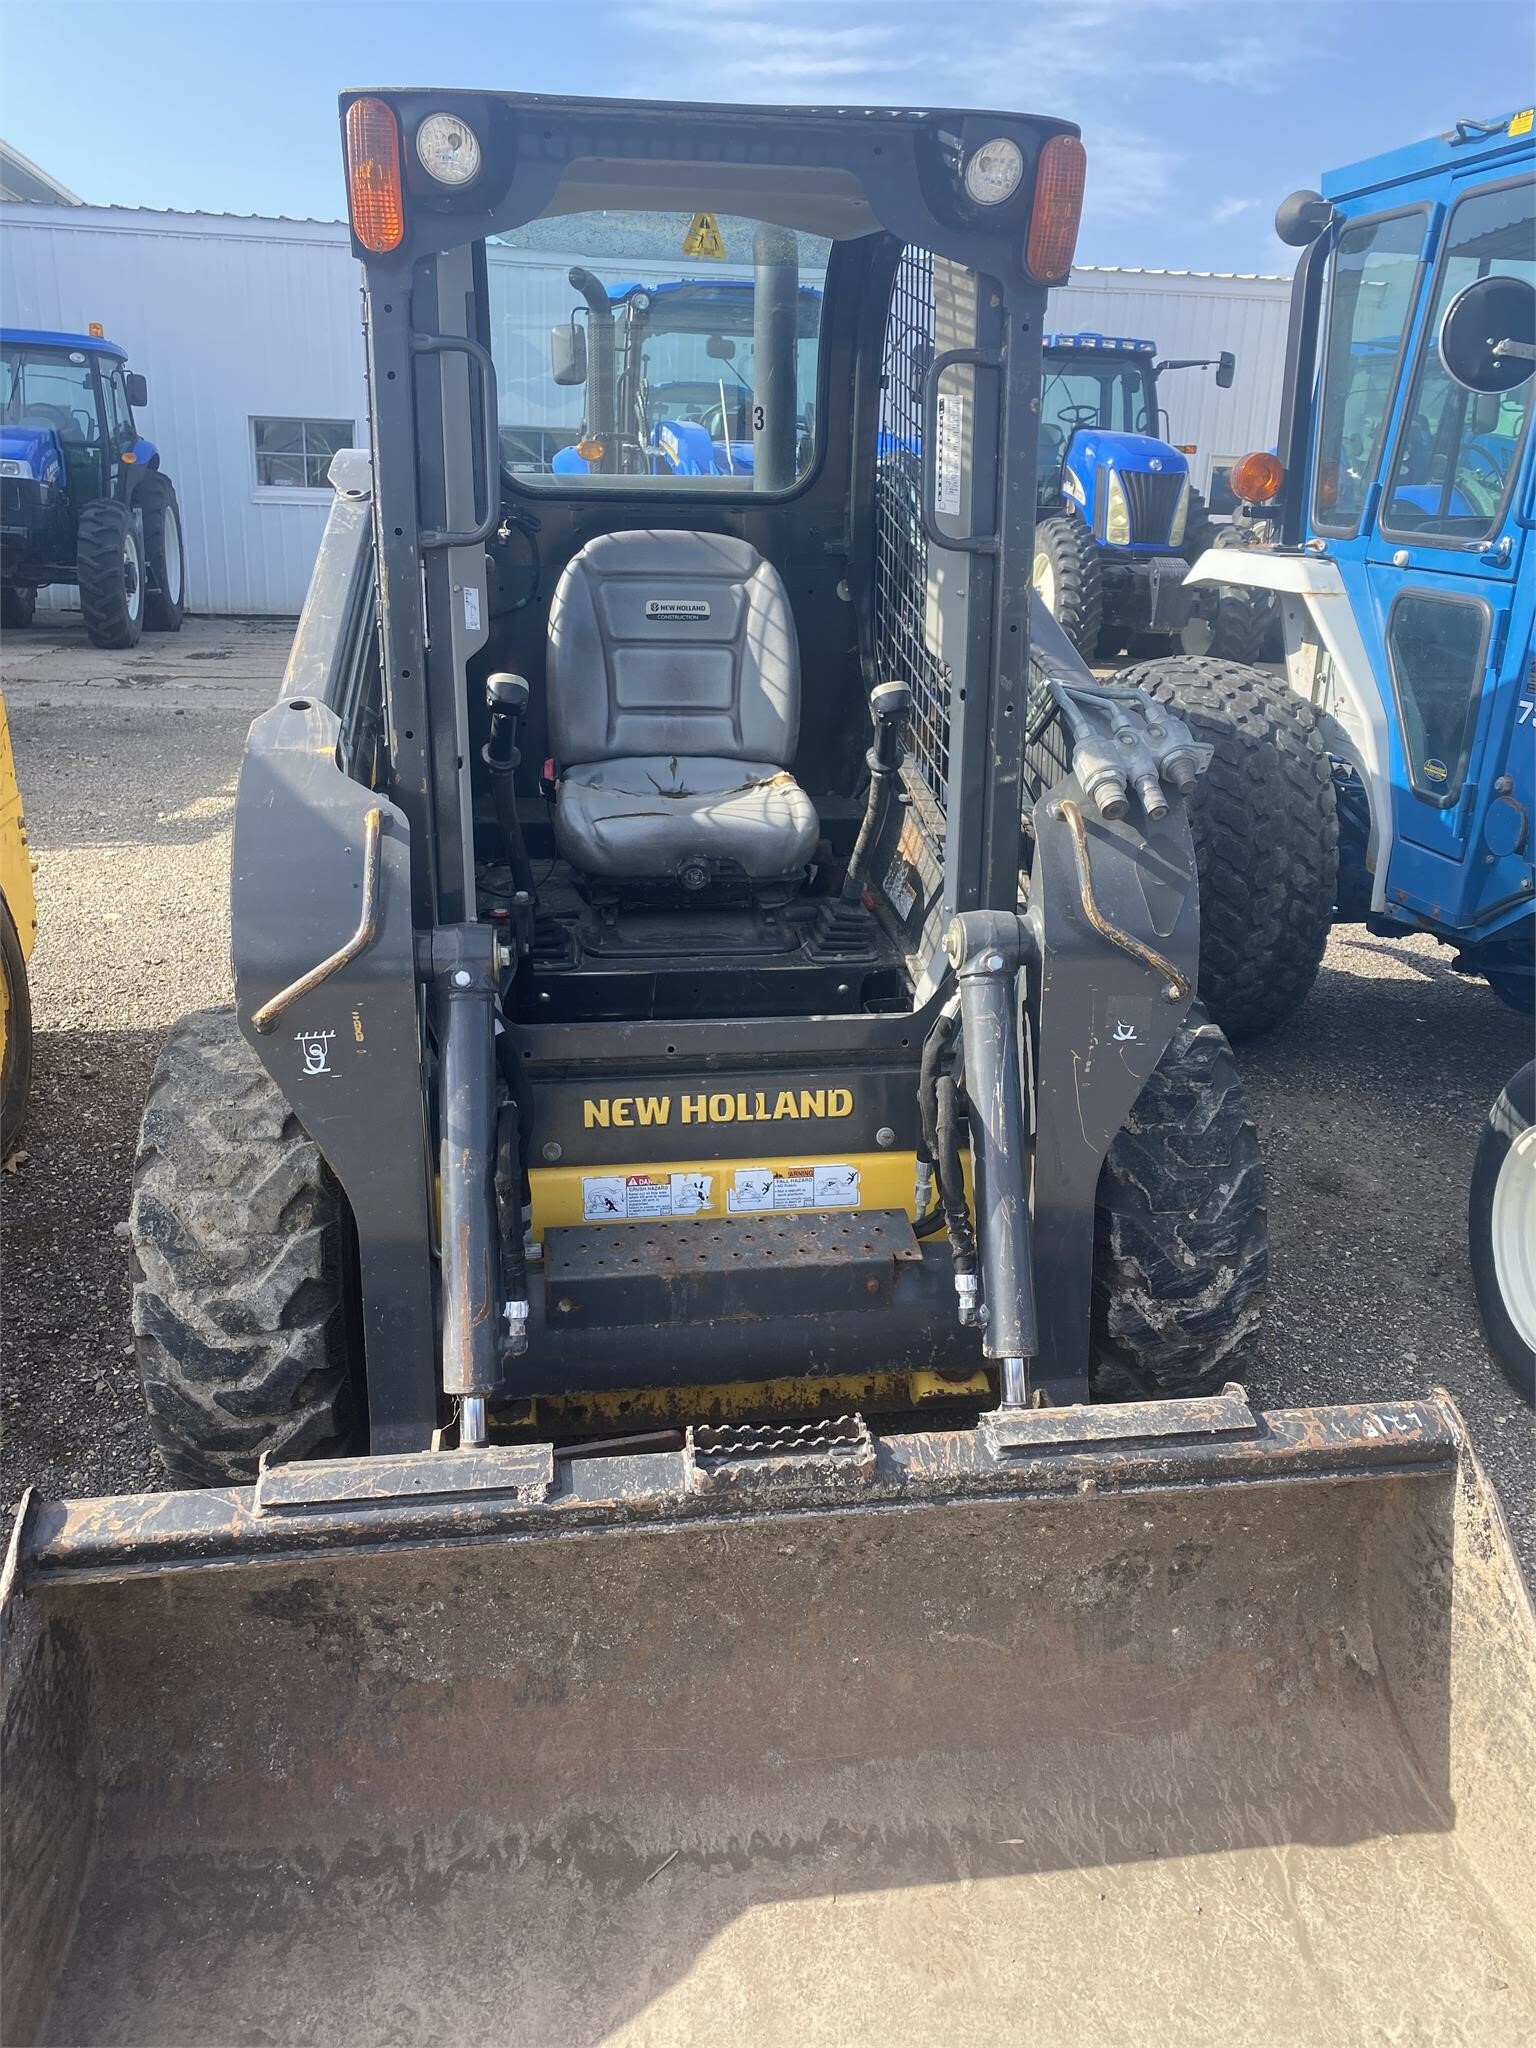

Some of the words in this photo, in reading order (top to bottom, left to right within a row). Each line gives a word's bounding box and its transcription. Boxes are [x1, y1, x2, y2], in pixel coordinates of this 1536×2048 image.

[753, 405, 765, 431] 3
[583, 1096, 671, 1128] NEW
[681, 1088, 853, 1124] HOLLAND
